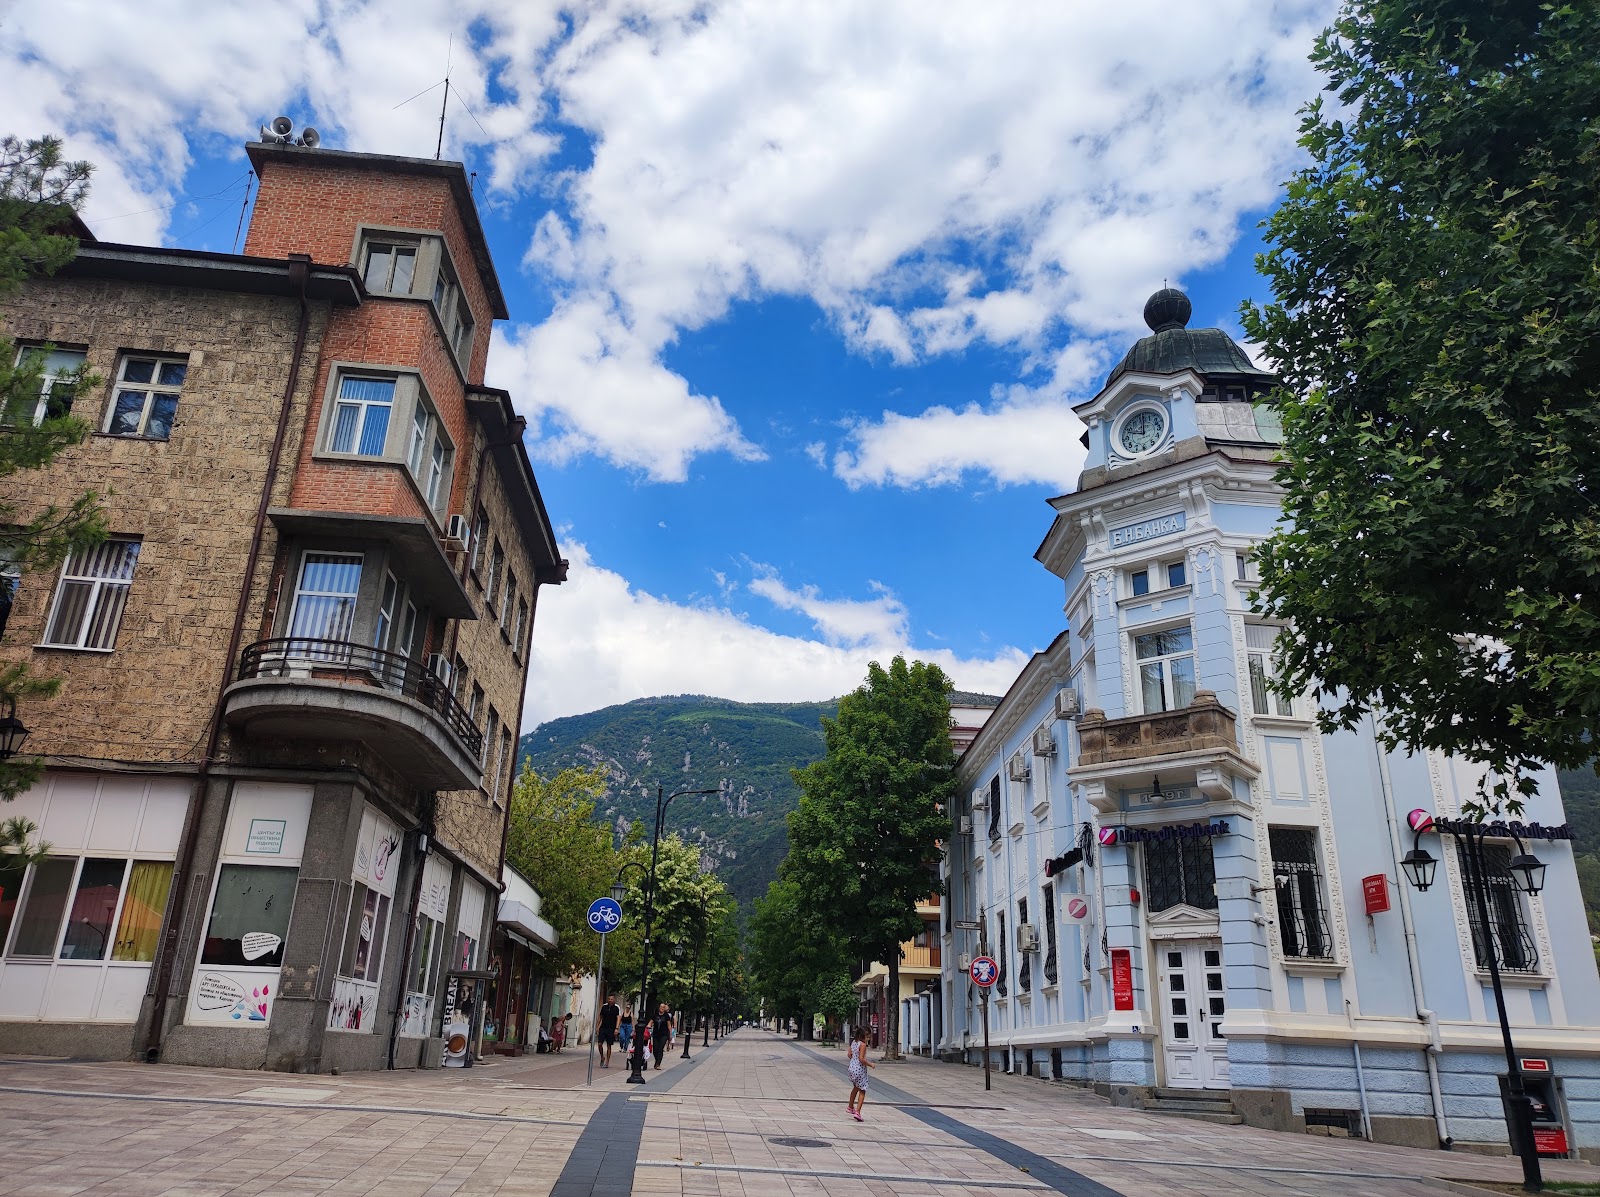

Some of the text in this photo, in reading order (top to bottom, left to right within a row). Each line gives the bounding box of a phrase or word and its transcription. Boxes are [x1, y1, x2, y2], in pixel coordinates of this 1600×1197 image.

[1176, 819, 1231, 840] Bulbank
[1508, 820, 1576, 840] Bulbank
[443, 978, 458, 1026] BREAK
